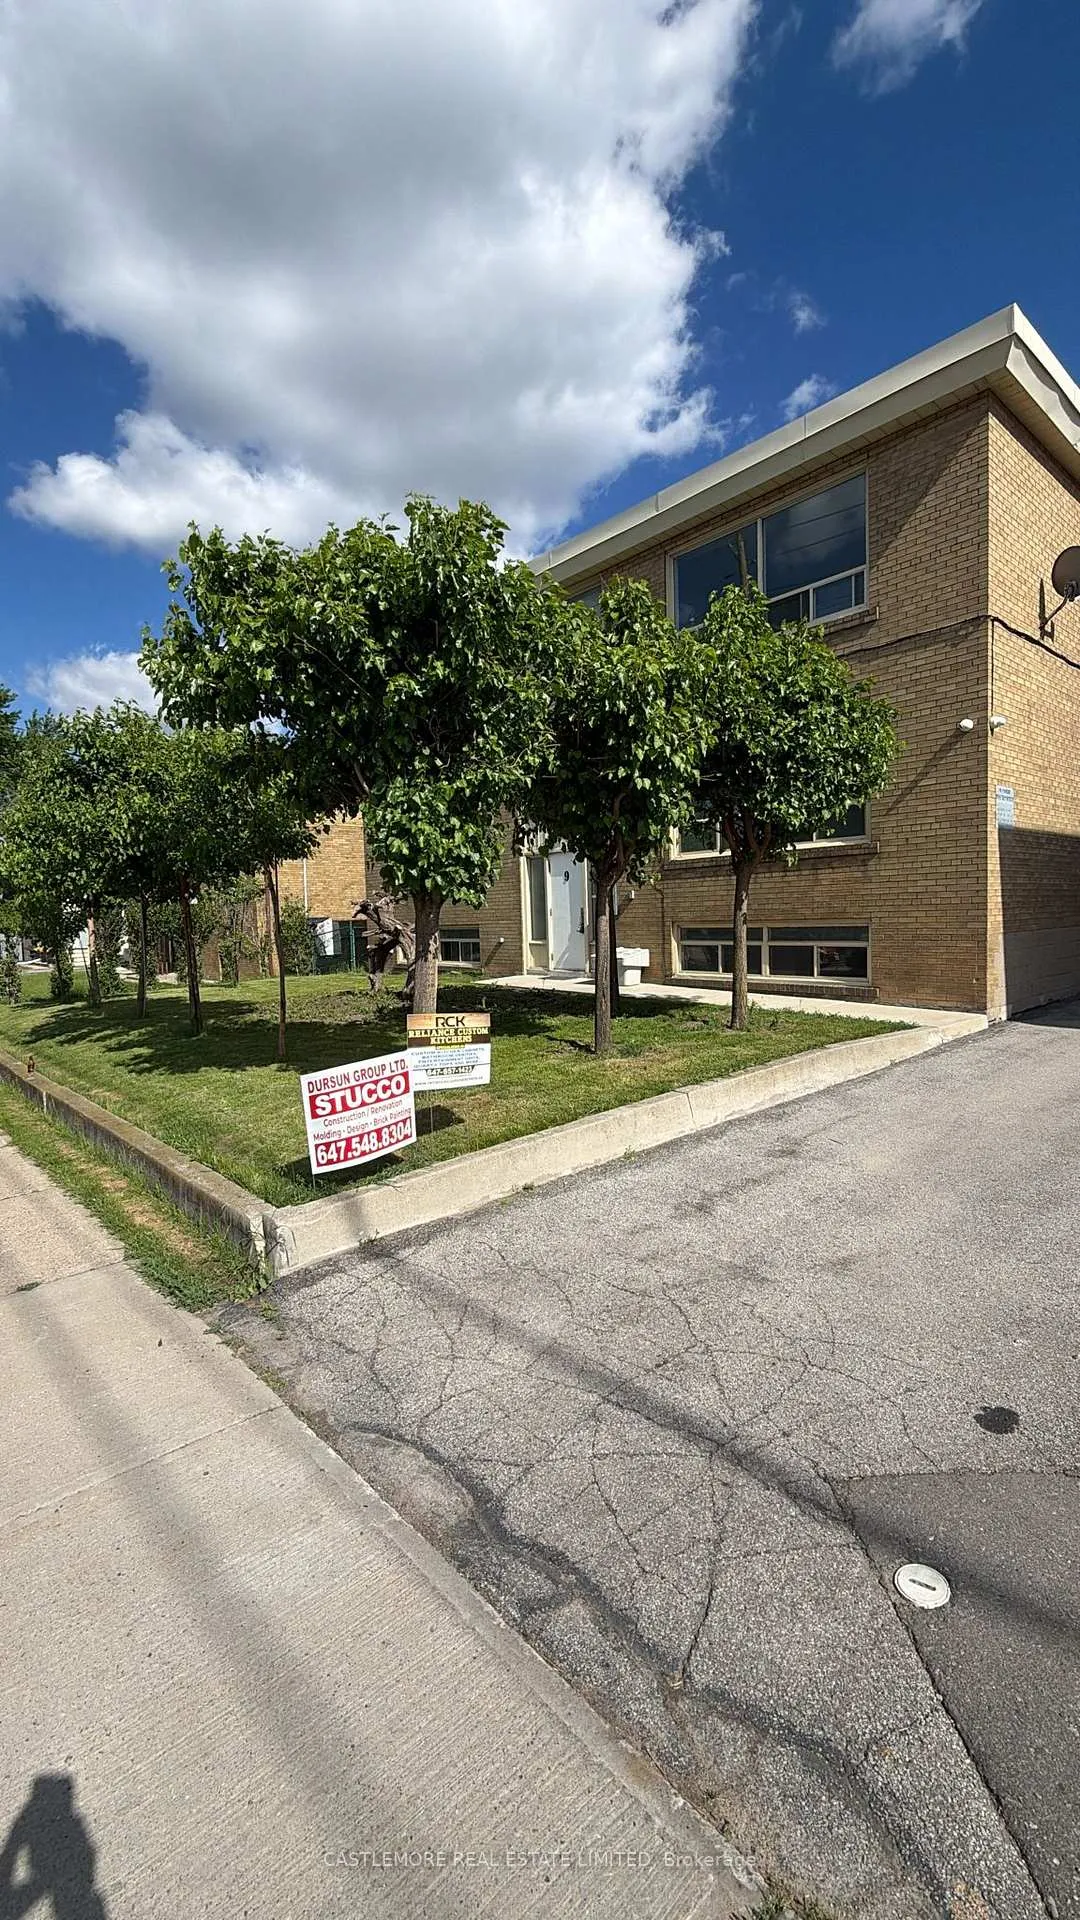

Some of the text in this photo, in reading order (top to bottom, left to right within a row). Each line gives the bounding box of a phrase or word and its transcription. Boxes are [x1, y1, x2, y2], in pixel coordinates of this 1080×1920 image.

[564, 871, 570, 882] 9
[408, 1027, 489, 1038] RELIANCE CUSTOM
[436, 1016, 466, 1027] RCK
[430, 1035, 473, 1044] KITCHENS
[307, 1072, 351, 1094] DURSUN
[353, 1063, 387, 1082] GROUP
[390, 1058, 409, 1073] LTD.
[314, 1075, 406, 1116] STUCCO
[313, 1107, 412, 1142] Molding Design Brick Painting
[323, 1110, 366, 1128] Construction
[370, 1099, 403, 1115] Renovation
[316, 1120, 413, 1165] 647.548.8304
